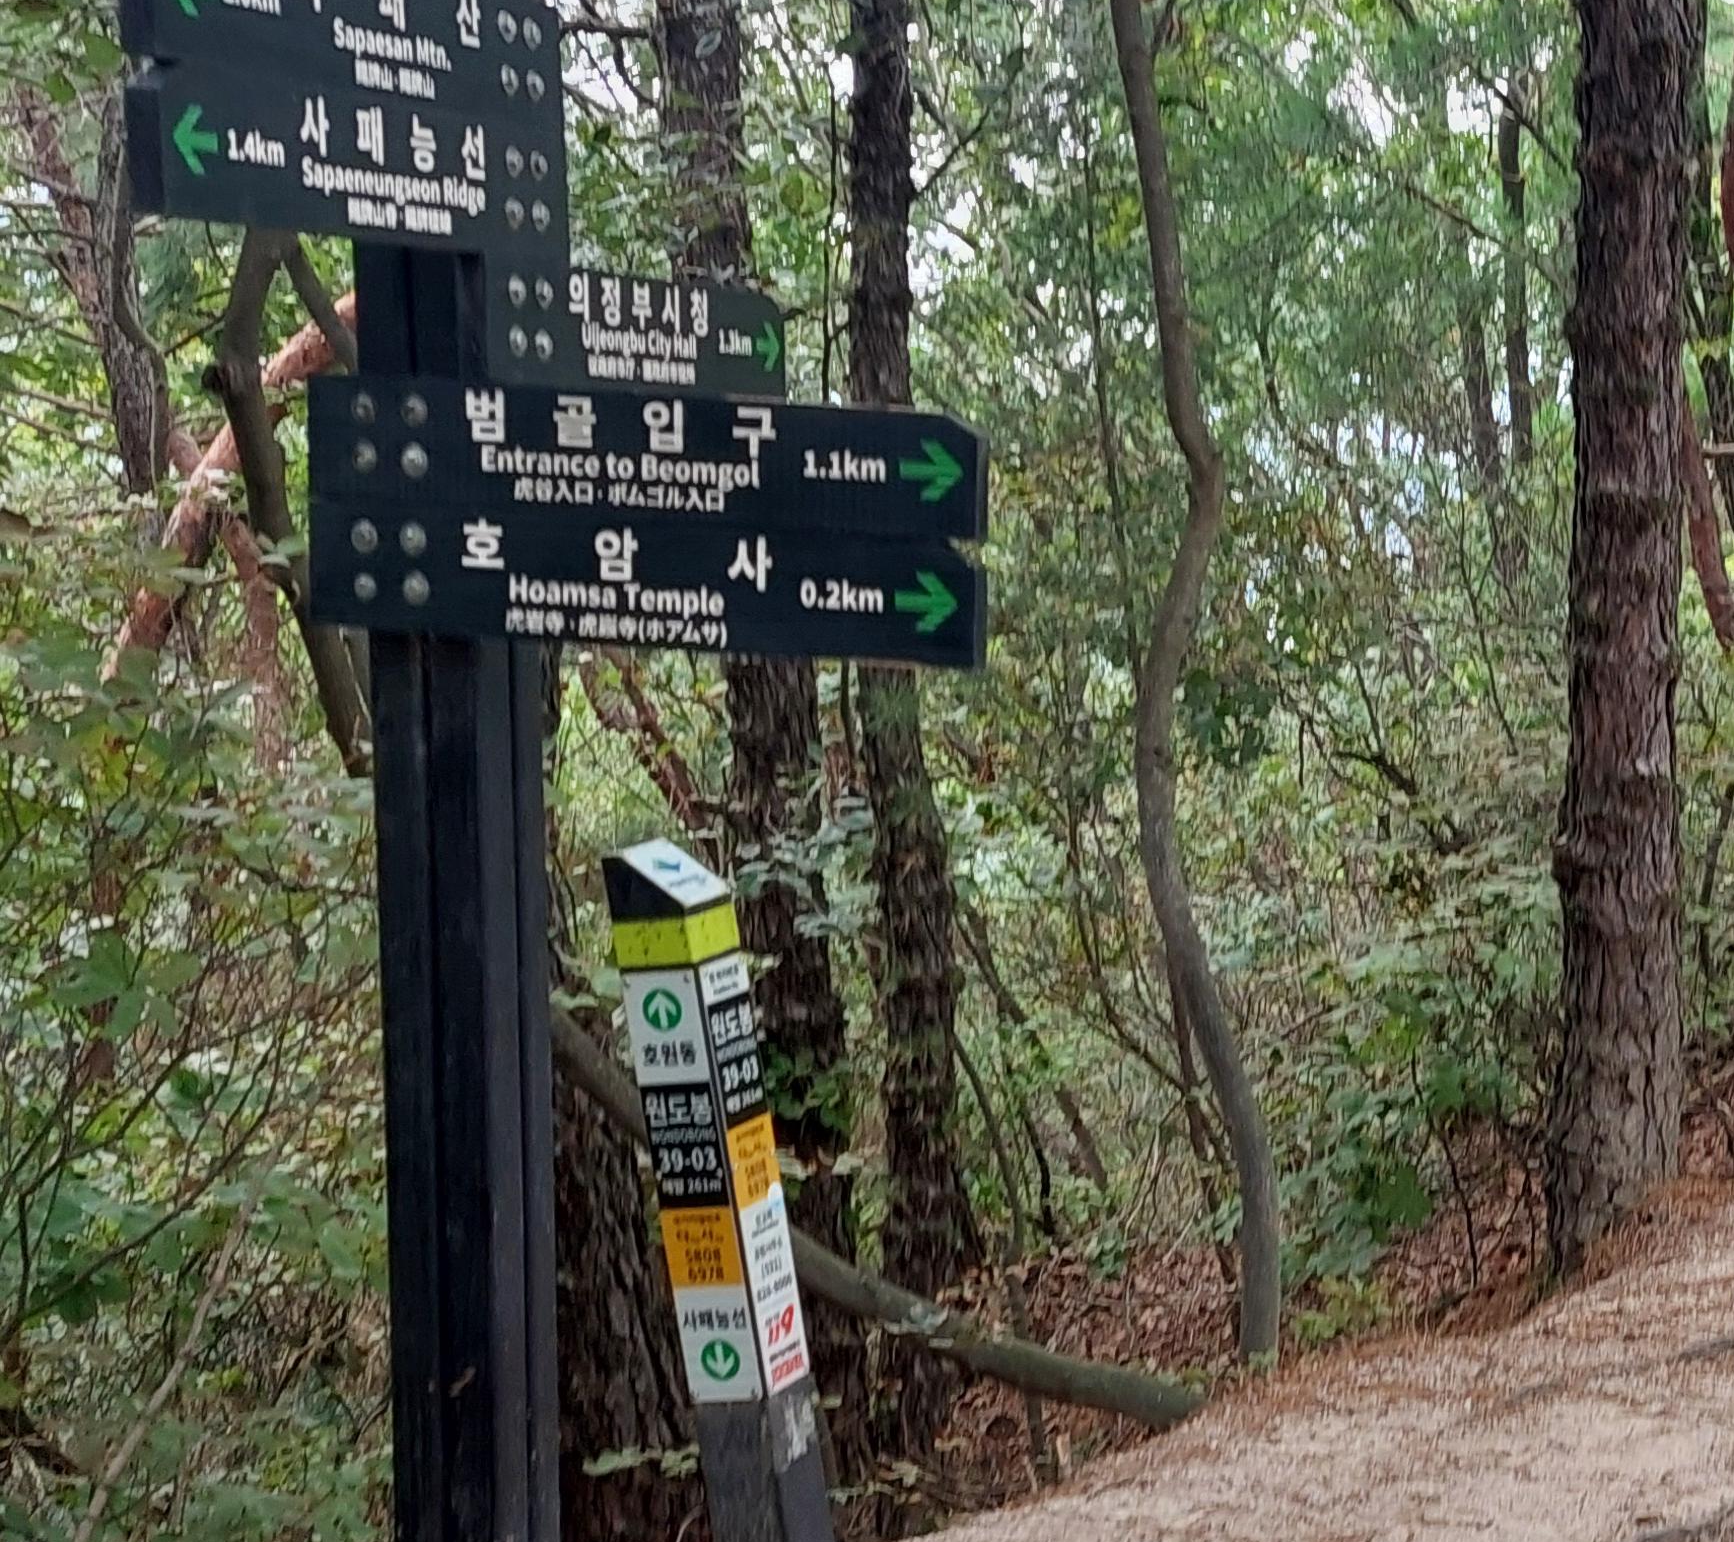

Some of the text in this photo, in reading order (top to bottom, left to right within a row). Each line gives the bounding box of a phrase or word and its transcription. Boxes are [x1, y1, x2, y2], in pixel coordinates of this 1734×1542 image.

[333, 15, 451, 71] Sapaesan Mtn.
[228, 95, 486, 182] 1.4km 사패능선
[302, 155, 441, 207] Sapaeneungseon
[443, 175, 486, 219] Ridge
[569, 271, 708, 338] 의정부시청
[581, 321, 697, 364] Uijeongbu City Hall
[465, 387, 886, 483] 범골입구 1.1km
[481, 444, 759, 493] Entrance to Beomgol
[461, 518, 883, 613] 호암사 0.2km
[508, 573, 724, 619] Hoamsa Temple
[646, 1091, 713, 1127] 원도봉
[768, 1303, 795, 1347] 119
